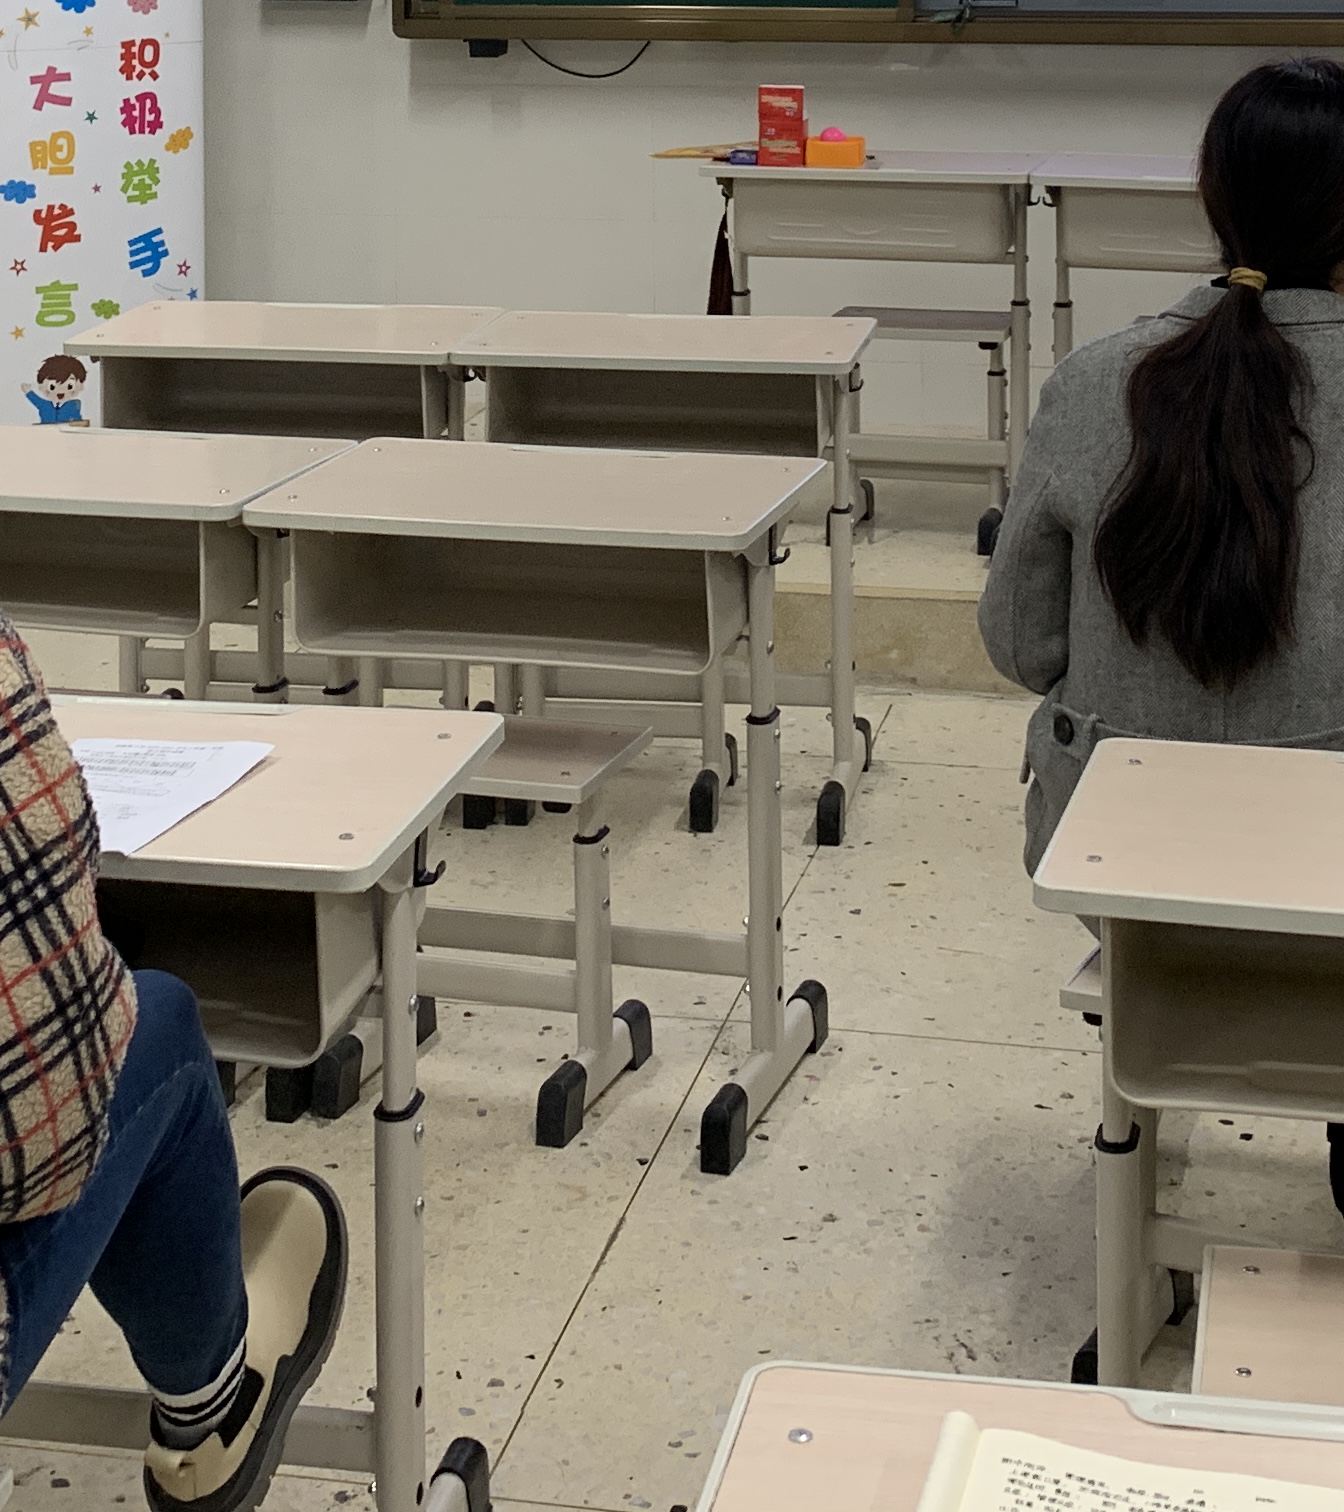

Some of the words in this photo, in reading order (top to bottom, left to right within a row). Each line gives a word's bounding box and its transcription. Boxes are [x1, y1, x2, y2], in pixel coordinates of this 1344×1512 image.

[29, 65, 82, 327] 大胆发言
[119, 38, 170, 278] 积极举手
